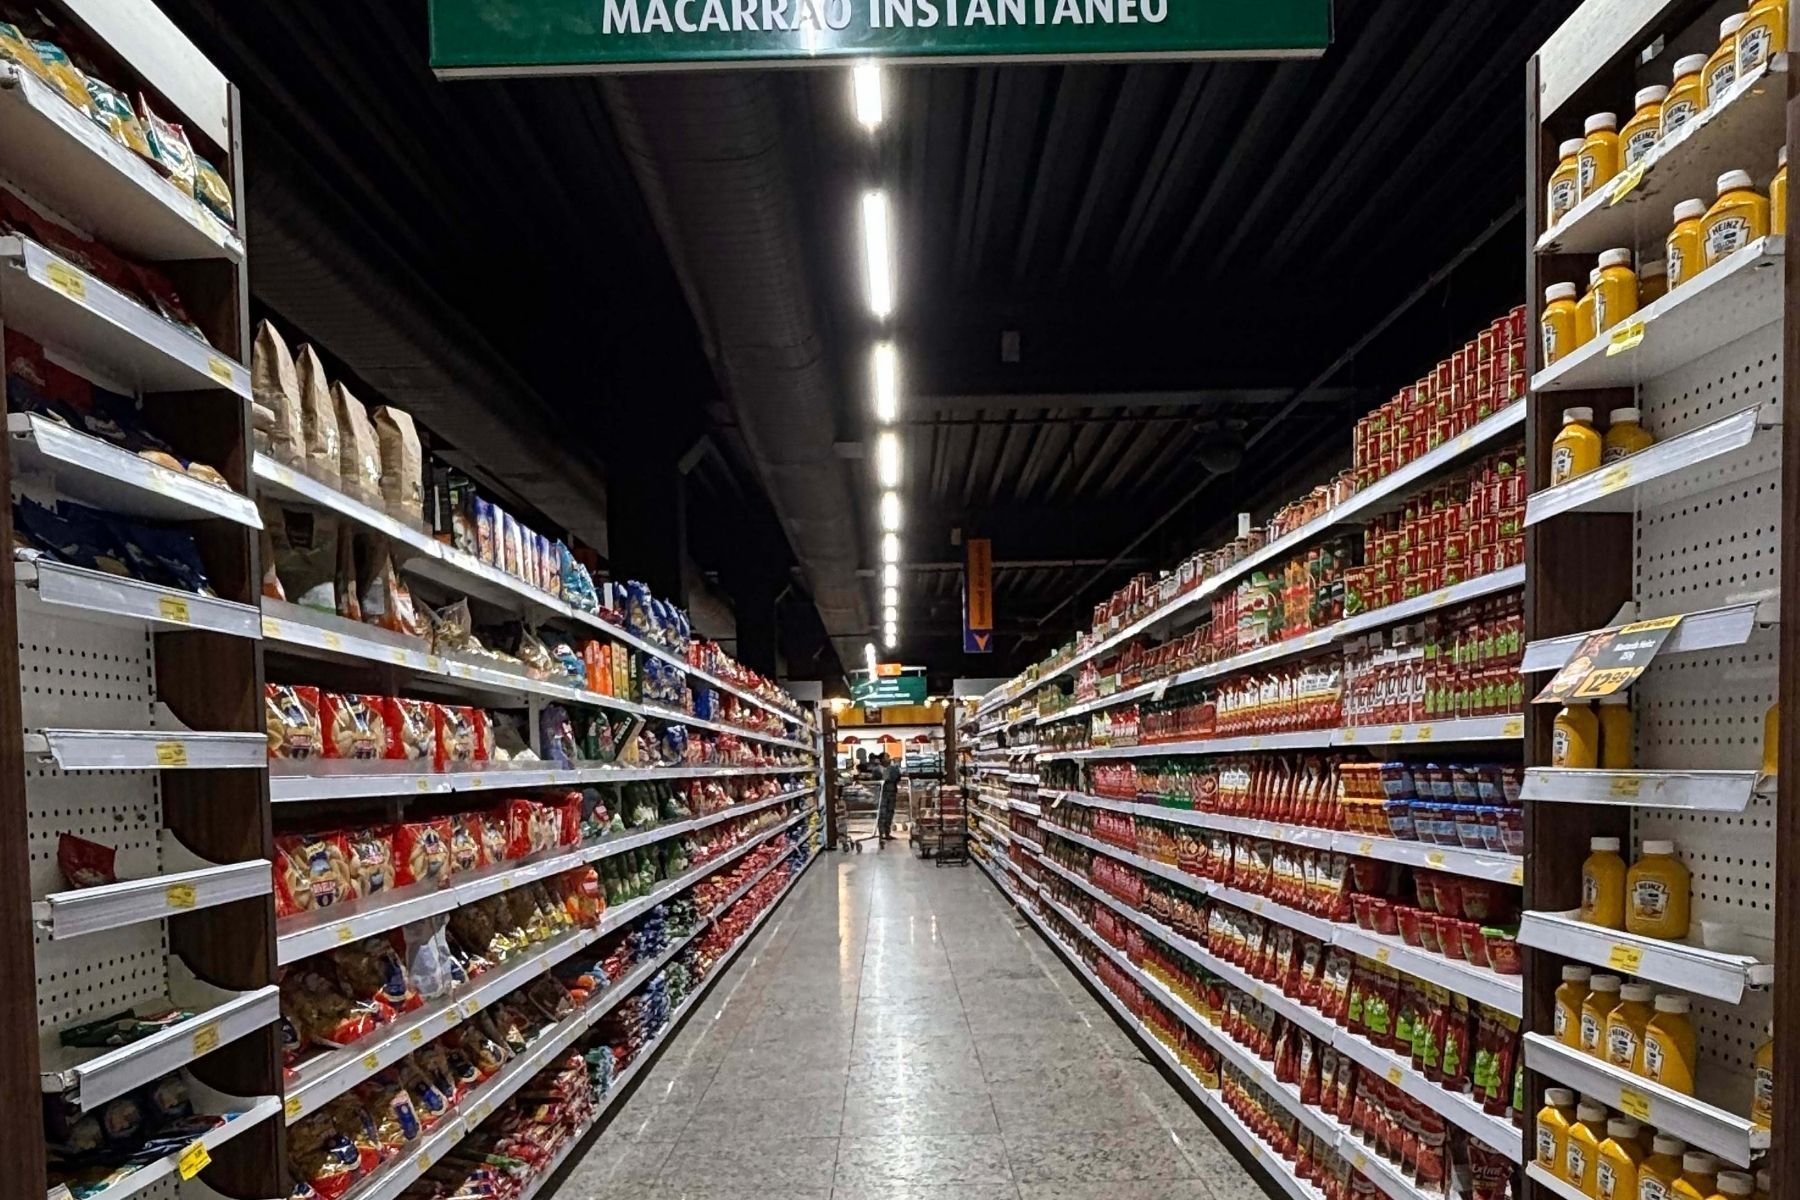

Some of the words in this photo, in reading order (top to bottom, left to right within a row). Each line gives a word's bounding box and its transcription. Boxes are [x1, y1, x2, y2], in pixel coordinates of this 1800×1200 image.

[1631, 130, 1657, 144] HEINZ
[1712, 220, 1739, 236] HEINZ
[1638, 882, 1662, 892] HEINZ
[1611, 1027, 1630, 1040] HEINZ
